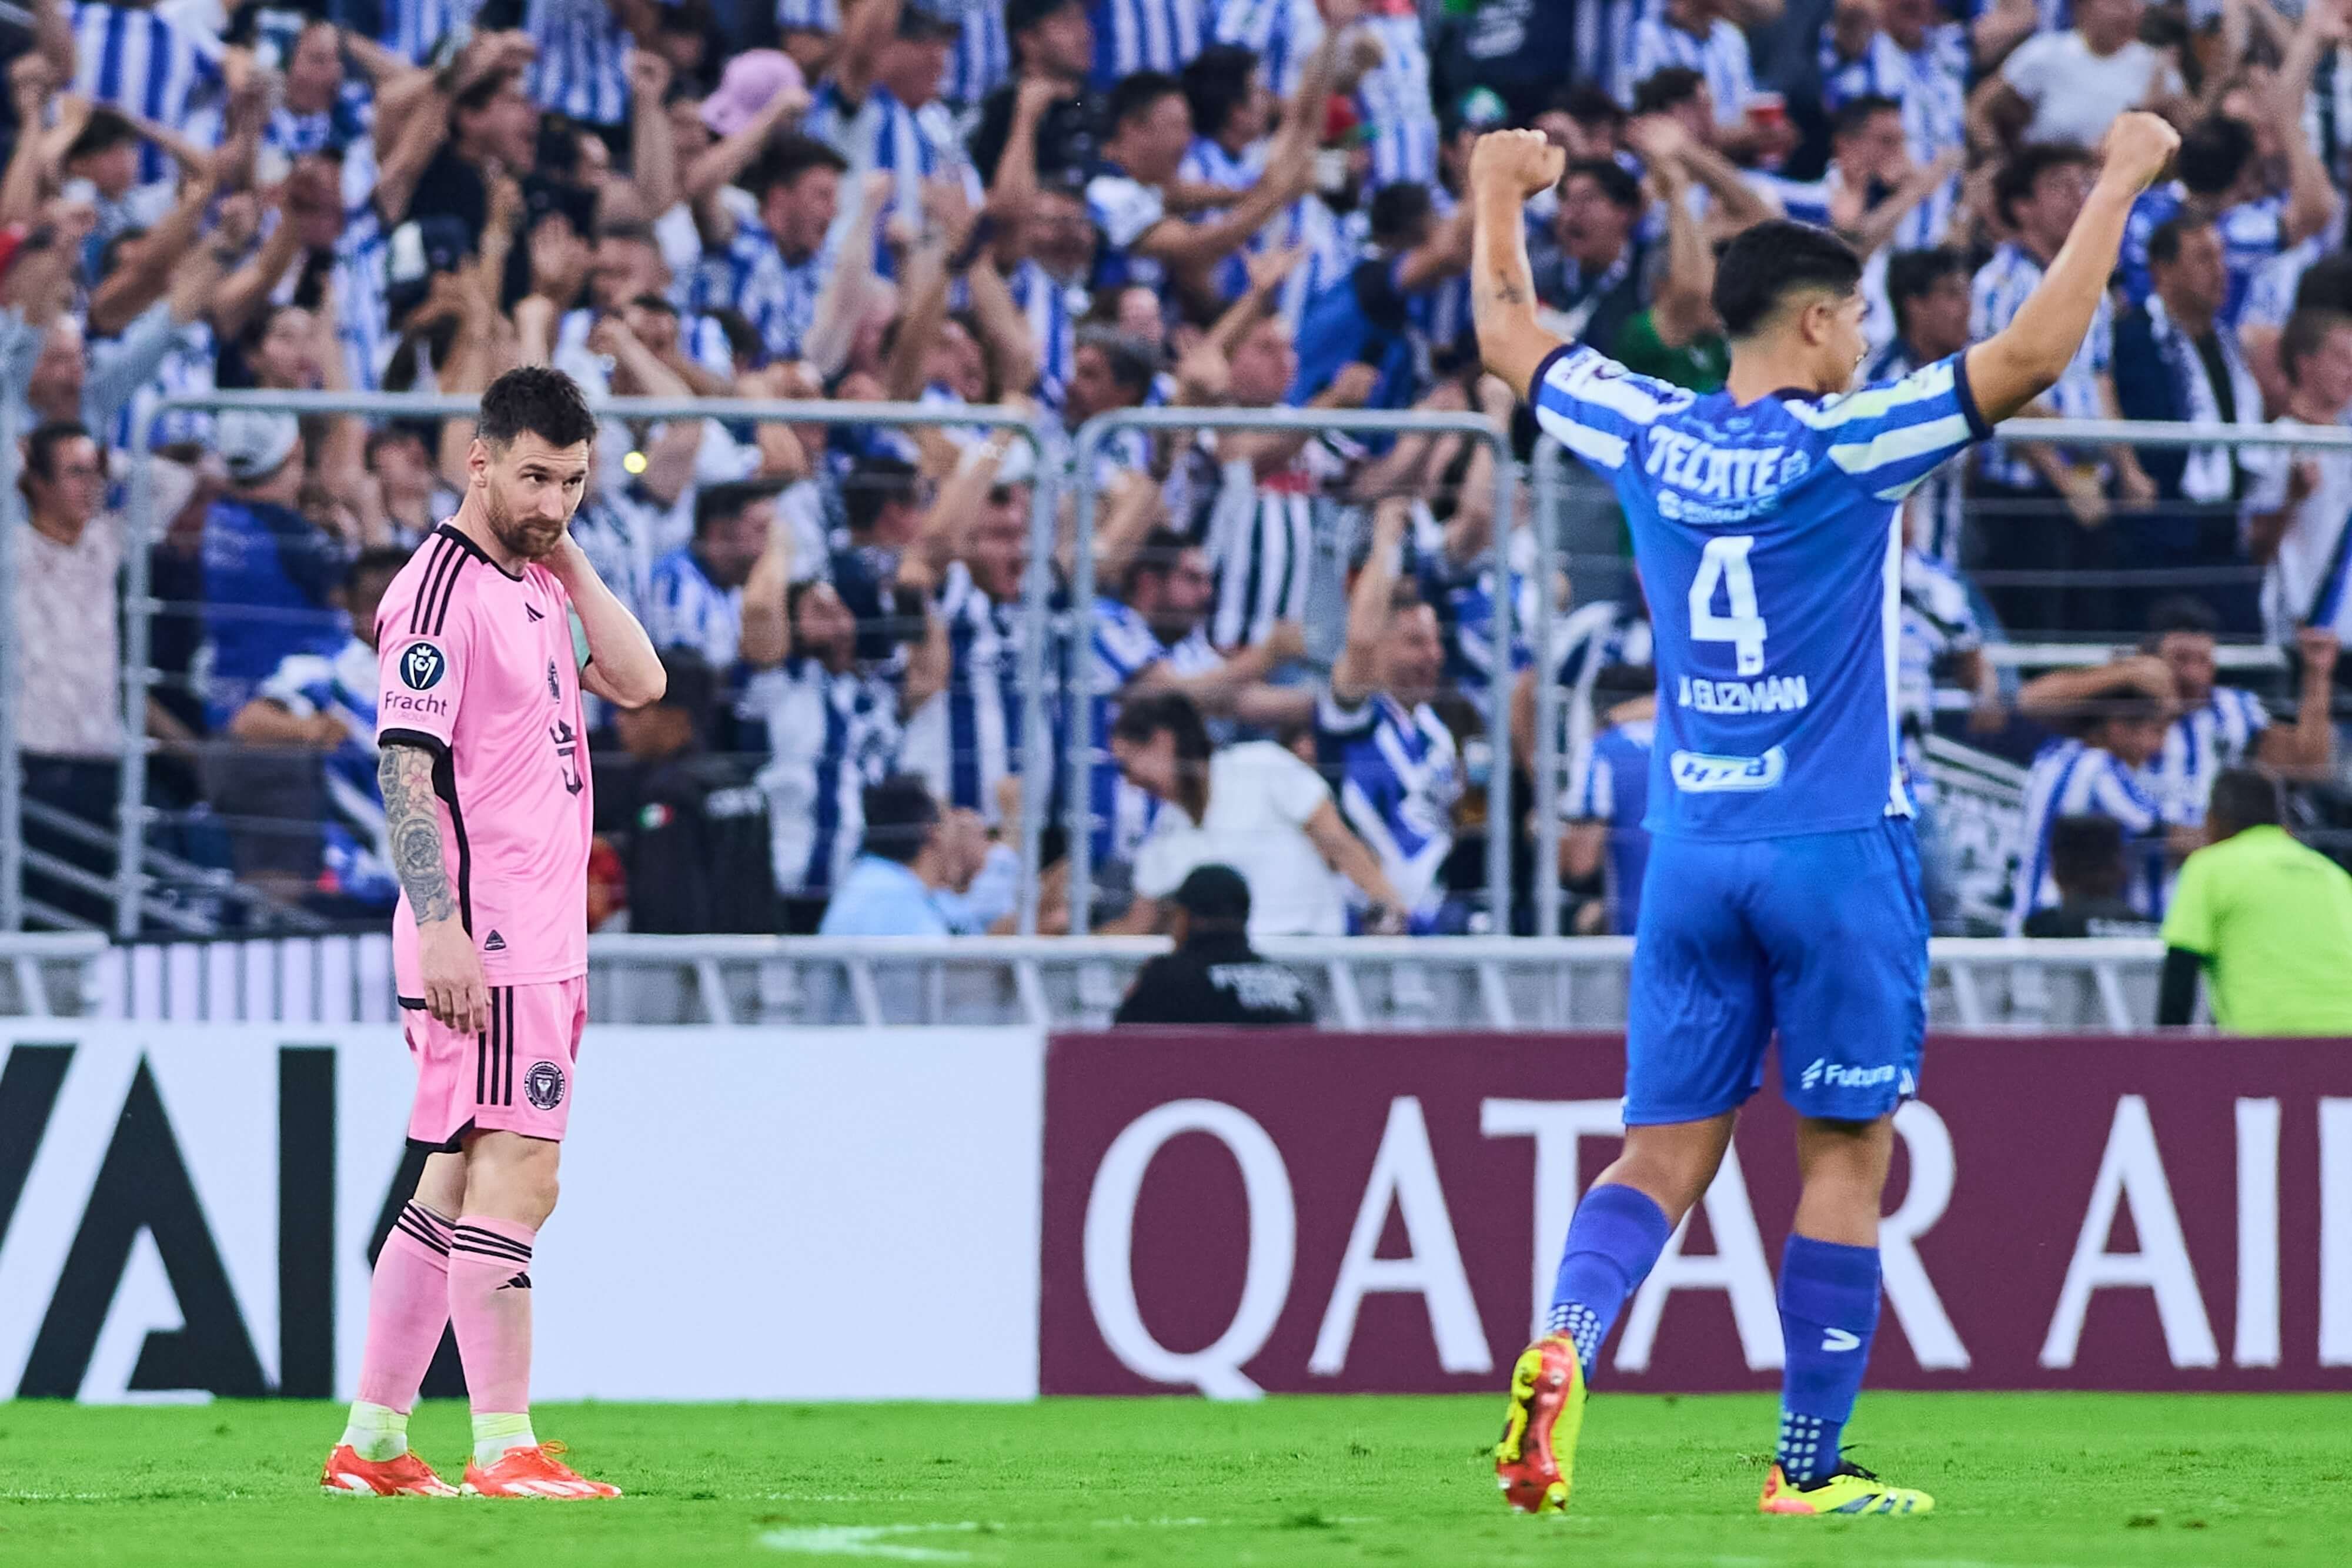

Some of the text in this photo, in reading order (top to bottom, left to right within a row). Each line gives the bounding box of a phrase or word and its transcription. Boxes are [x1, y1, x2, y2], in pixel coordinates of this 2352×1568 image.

[1645, 424, 1786, 499] TECATE
[1689, 536, 1768, 676] 4
[384, 690, 448, 717] Fracht
[1084, 1095, 1972, 1402] QATAR
